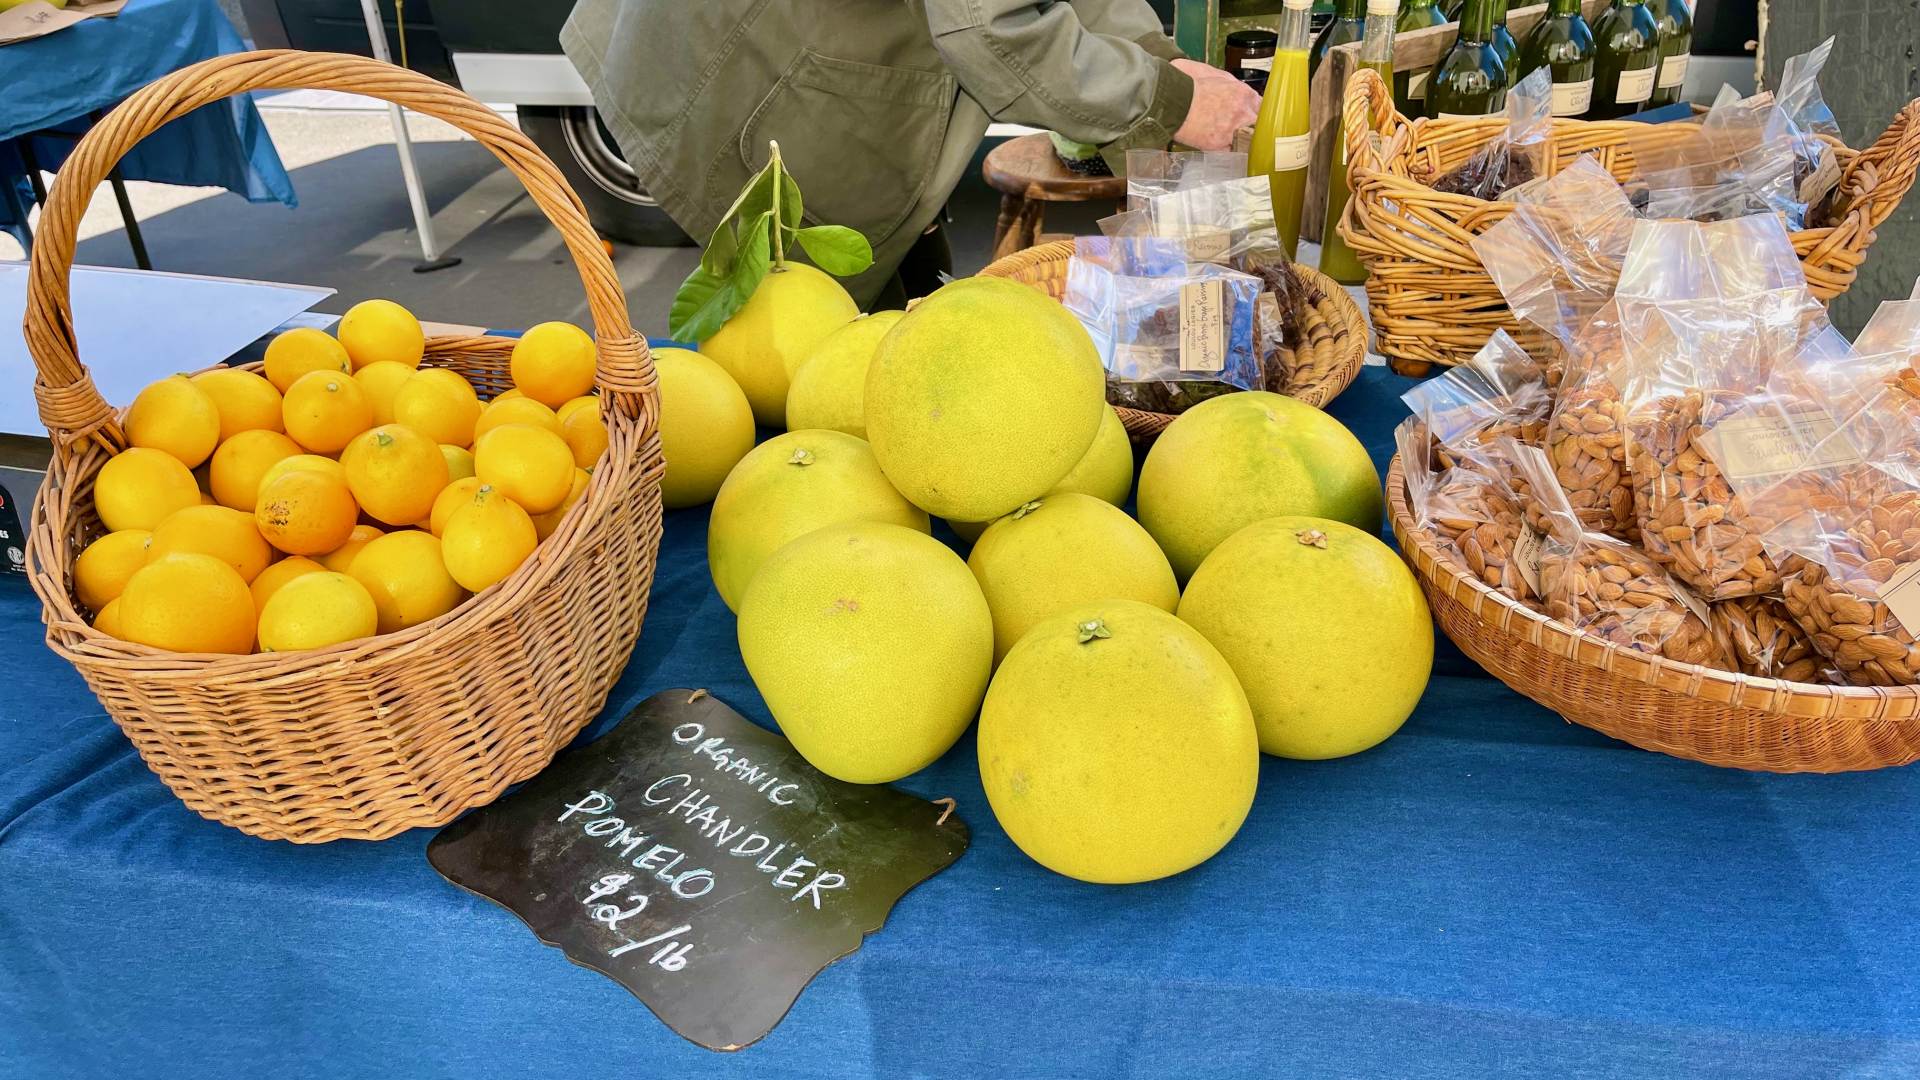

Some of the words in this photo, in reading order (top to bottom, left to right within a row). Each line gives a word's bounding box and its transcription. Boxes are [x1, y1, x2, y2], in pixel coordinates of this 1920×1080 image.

[672, 723, 799, 805] ORGANIC
[557, 790, 715, 898] POMELO
[642, 773, 845, 909] CHANDLER
